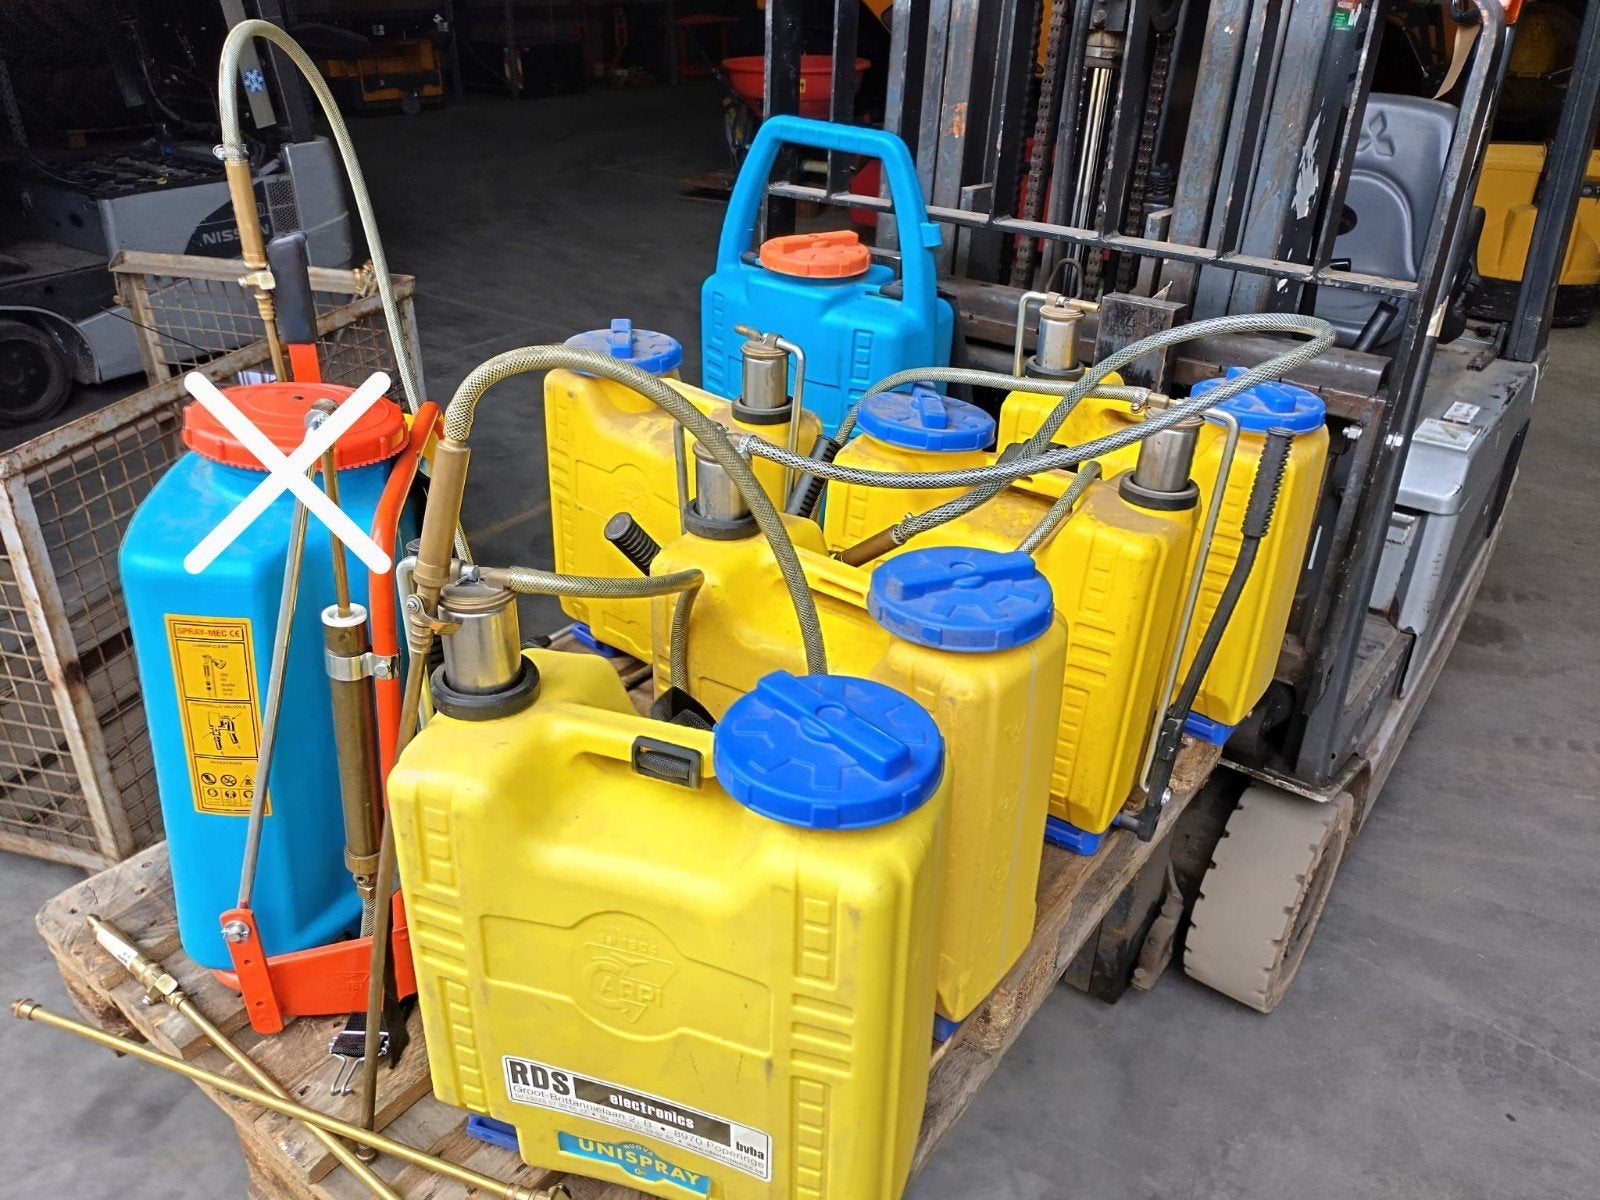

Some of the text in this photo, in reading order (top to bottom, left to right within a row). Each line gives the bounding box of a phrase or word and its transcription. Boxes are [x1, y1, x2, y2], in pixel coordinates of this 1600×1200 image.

[202, 223, 270, 246] NISSN
[176, 626, 228, 638] SPRAY-MEC
[508, 1060, 571, 1096] RDS
[608, 1093, 695, 1130] electronics
[735, 1140, 765, 1161] bvba
[578, 1138, 701, 1186] UNISPRAY
[674, 1129, 703, 1147] 8970
[706, 1141, 765, 1169] Poperinge
